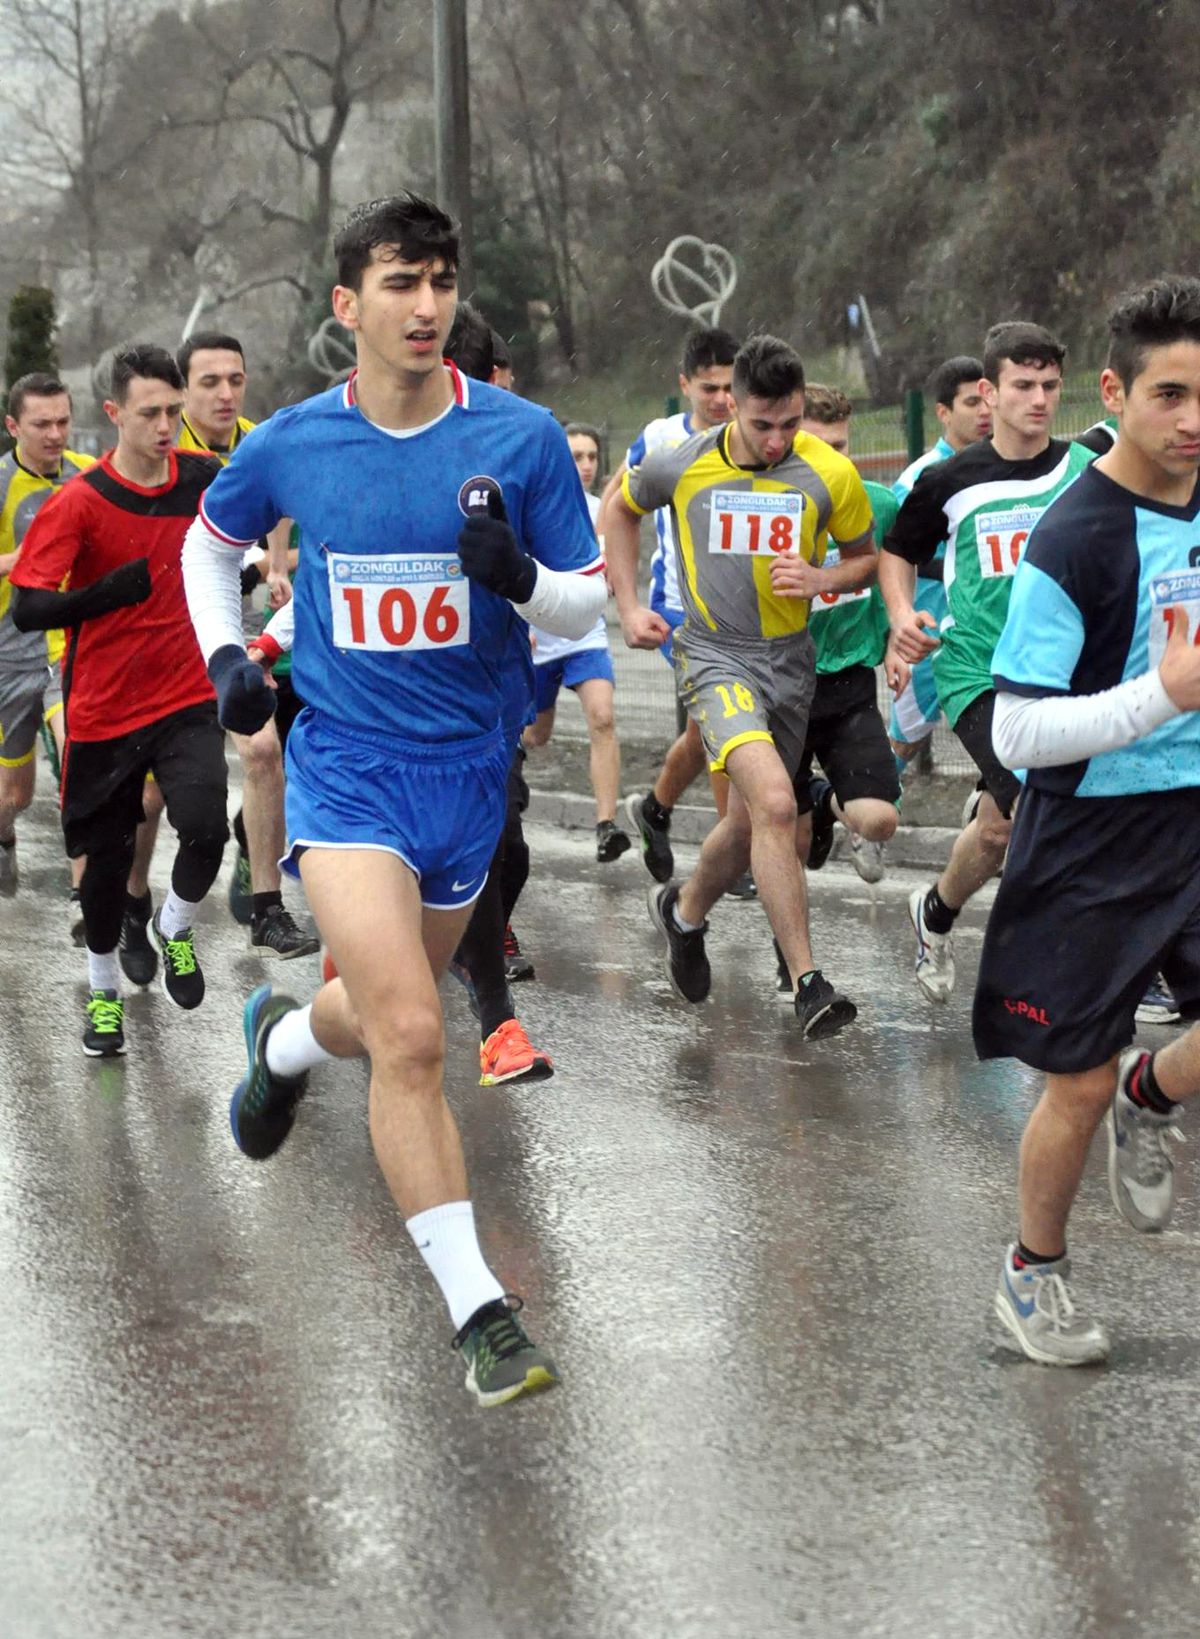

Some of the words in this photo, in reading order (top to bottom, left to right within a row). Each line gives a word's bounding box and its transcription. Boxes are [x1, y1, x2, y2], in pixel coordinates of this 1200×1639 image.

[727, 495, 787, 506] ZONGULDAK
[719, 513, 793, 553] 118
[350, 561, 445, 574] ZONGULDAK
[342, 586, 460, 646] 106
[714, 682, 755, 718] 18
